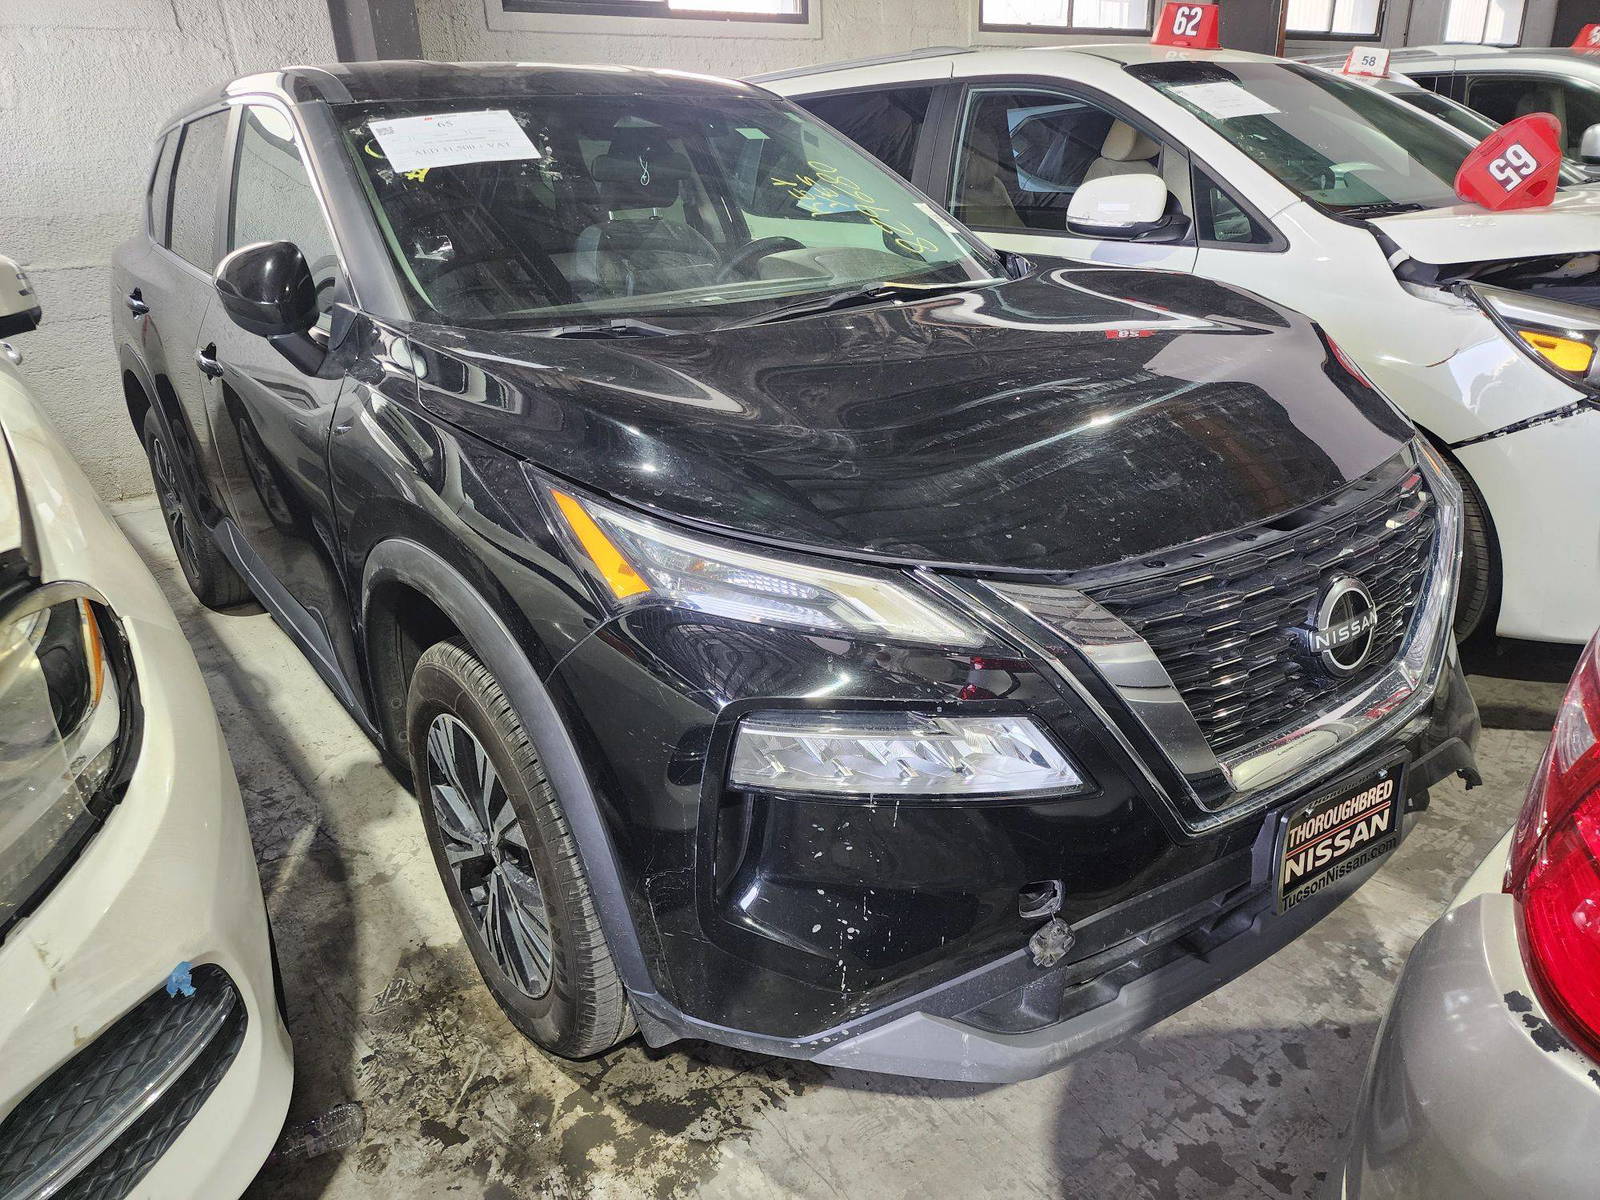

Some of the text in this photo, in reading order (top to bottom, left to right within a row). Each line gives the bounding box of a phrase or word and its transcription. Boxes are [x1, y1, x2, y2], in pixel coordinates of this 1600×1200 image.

[1173, 6, 1203, 36] 62
[1361, 55, 1377, 67] 58
[1489, 144, 1537, 192] 65
[1315, 611, 1378, 649] NISSAN
[1289, 779, 1394, 848] THOROUGHBRED
[1285, 808, 1390, 885] NISSAN
[1282, 837, 1397, 913] TucsonNissan.com
